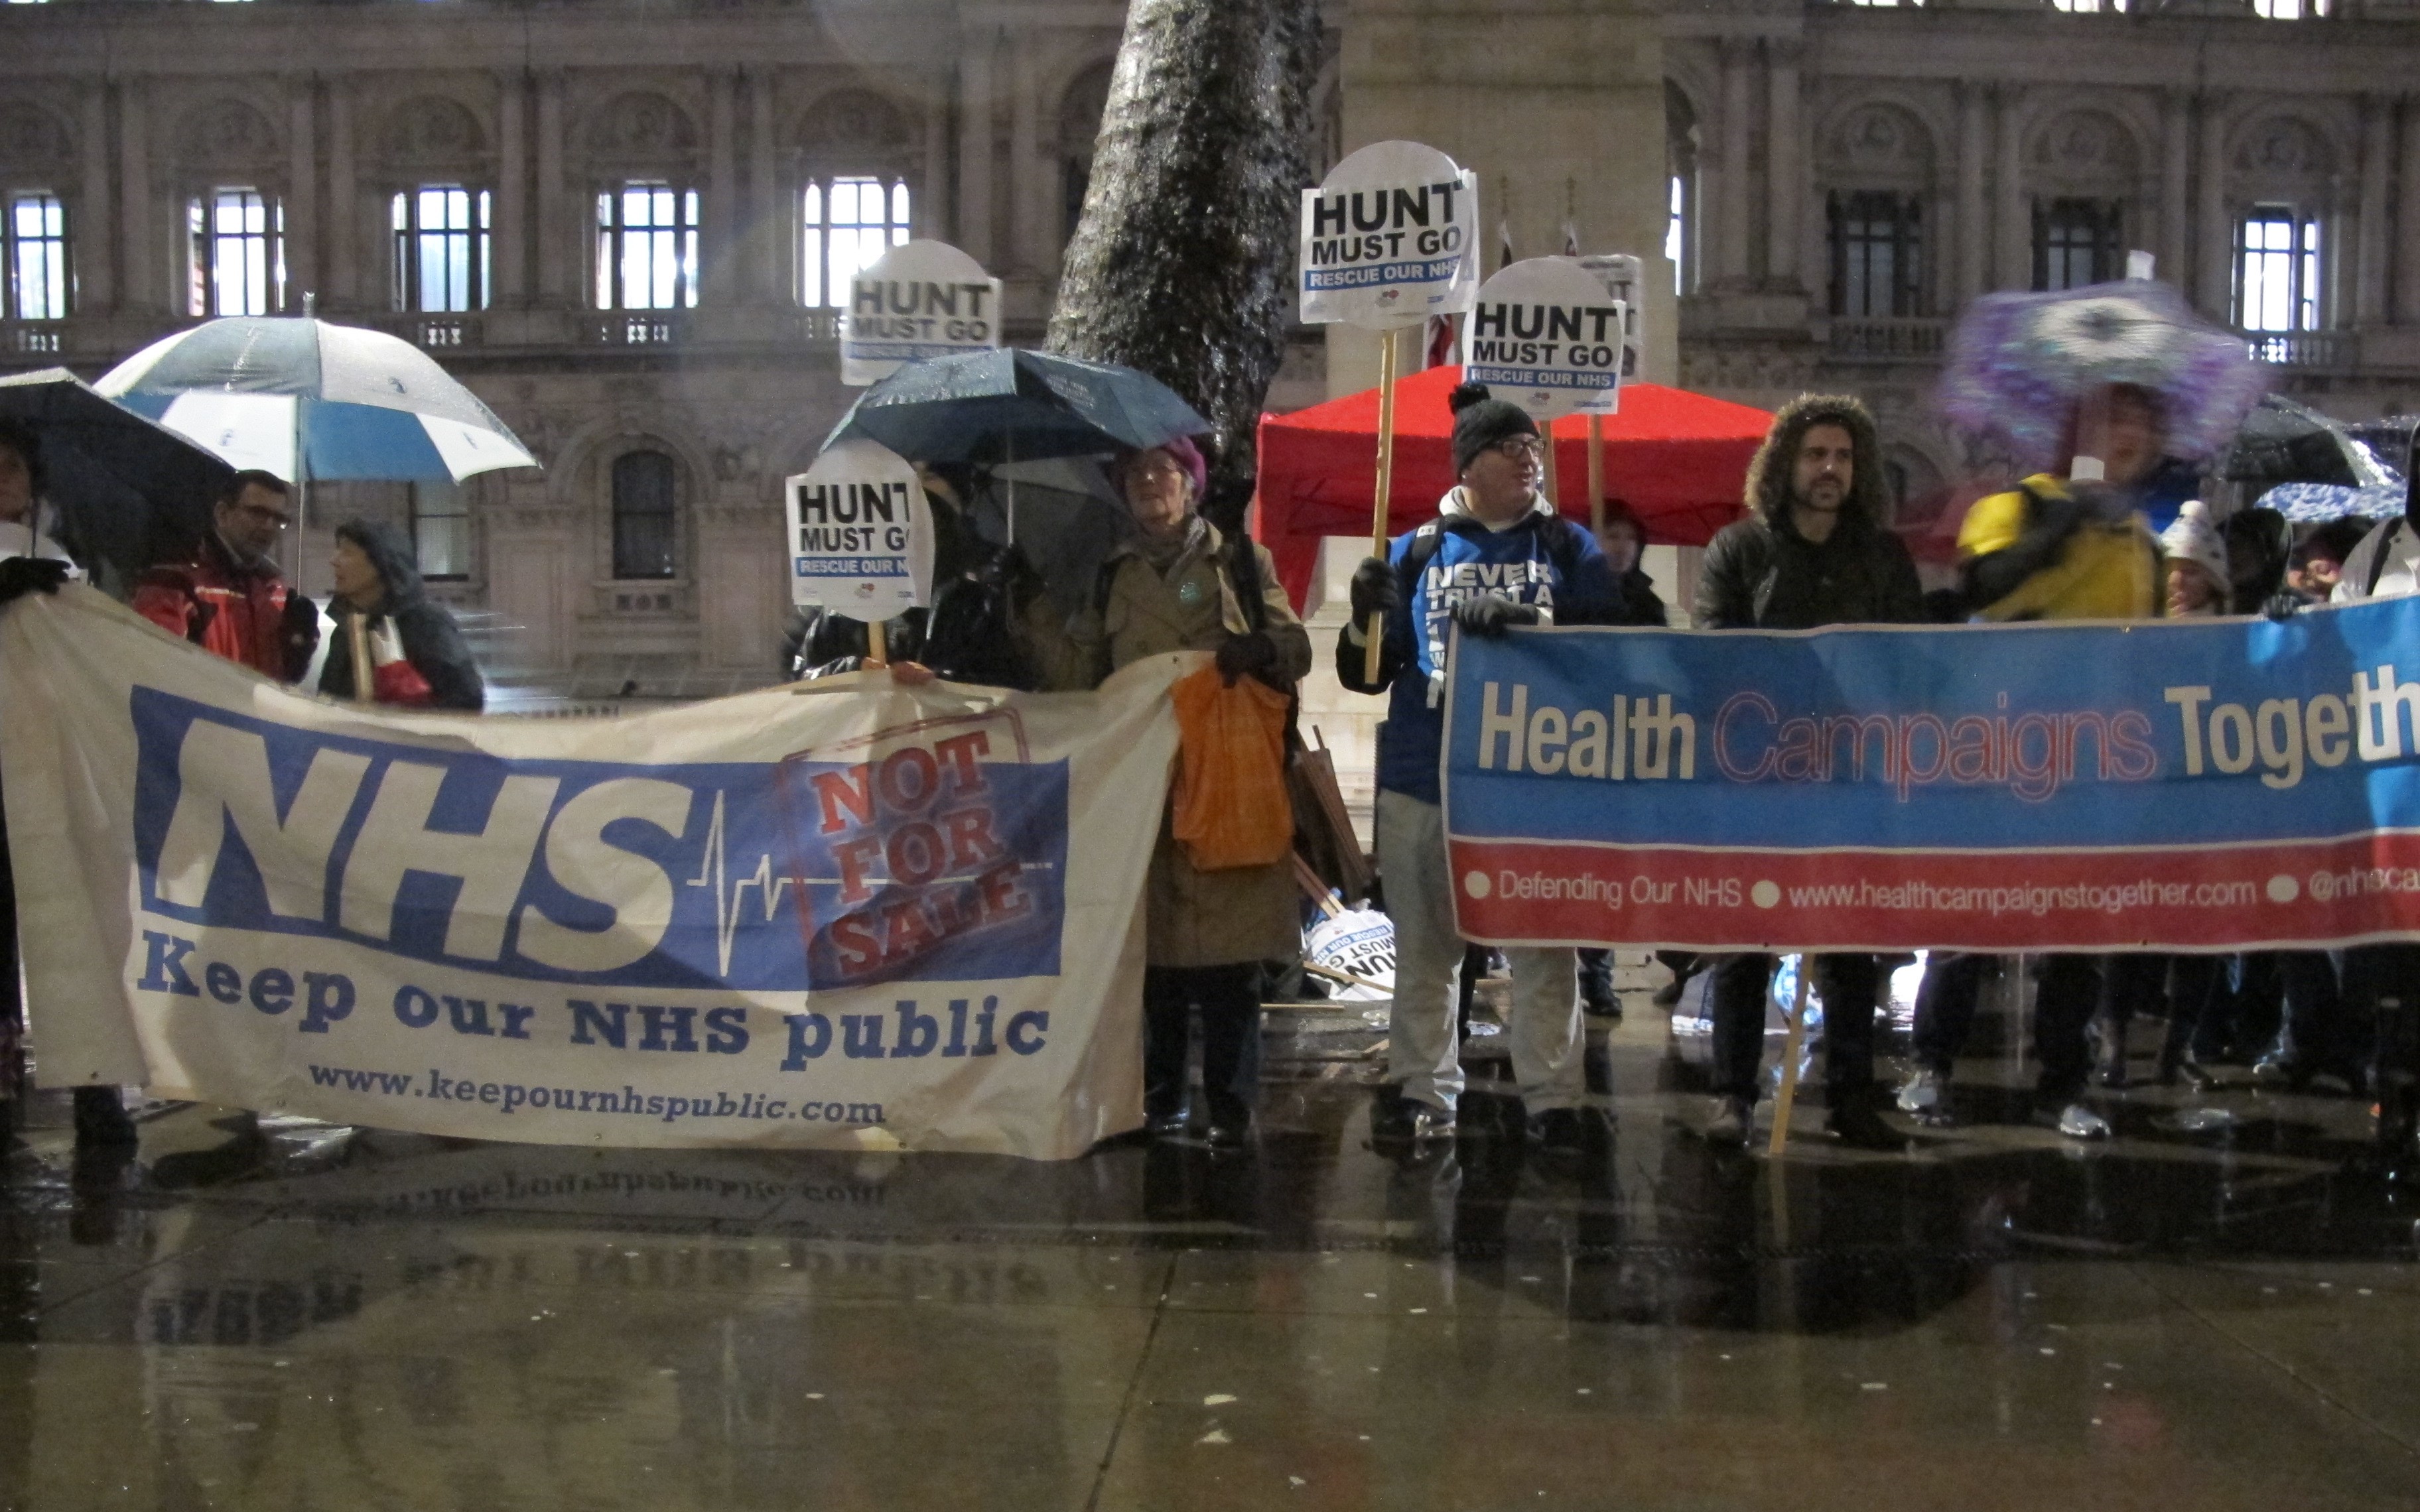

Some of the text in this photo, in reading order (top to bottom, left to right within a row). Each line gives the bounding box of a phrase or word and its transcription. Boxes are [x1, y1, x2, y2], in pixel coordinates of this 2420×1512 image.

[1313, 180, 1462, 237] HUNT
[1311, 225, 1461, 265] MUST GO
[1310, 268, 1380, 287] RESCUE
[1384, 265, 1425, 281] OUR
[854, 281, 991, 317] HUNT
[852, 318, 989, 342] MUST GO
[1475, 302, 1617, 342] HUNT
[1473, 340, 1613, 367] MUST GO
[1471, 367, 1611, 386] RESCUE OUR NHS
[799, 527, 909, 552] MUST G
[800, 559, 858, 574] RESCUE
[862, 560, 894, 574] OUR
[1427, 560, 1553, 590] NEVER
[1534, 584, 1554, 605] A
[1479, 681, 1696, 781] Health
[1713, 691, 2157, 802] Campaigns
[811, 730, 990, 834] NOT
[155, 717, 694, 972] NHS
[832, 808, 1006, 905] FOR
[1500, 870, 1622, 911] Defending
[1630, 875, 1677, 904] Our
[1684, 876, 1742, 907] NHS
[1790, 877, 2255, 916] www.healthcampaignstogether.com
[831, 859, 1032, 976] SALE
[137, 930, 1049, 1072] Keep our NHS public
[308, 1064, 887, 1124] www.keepournhspublic.com
